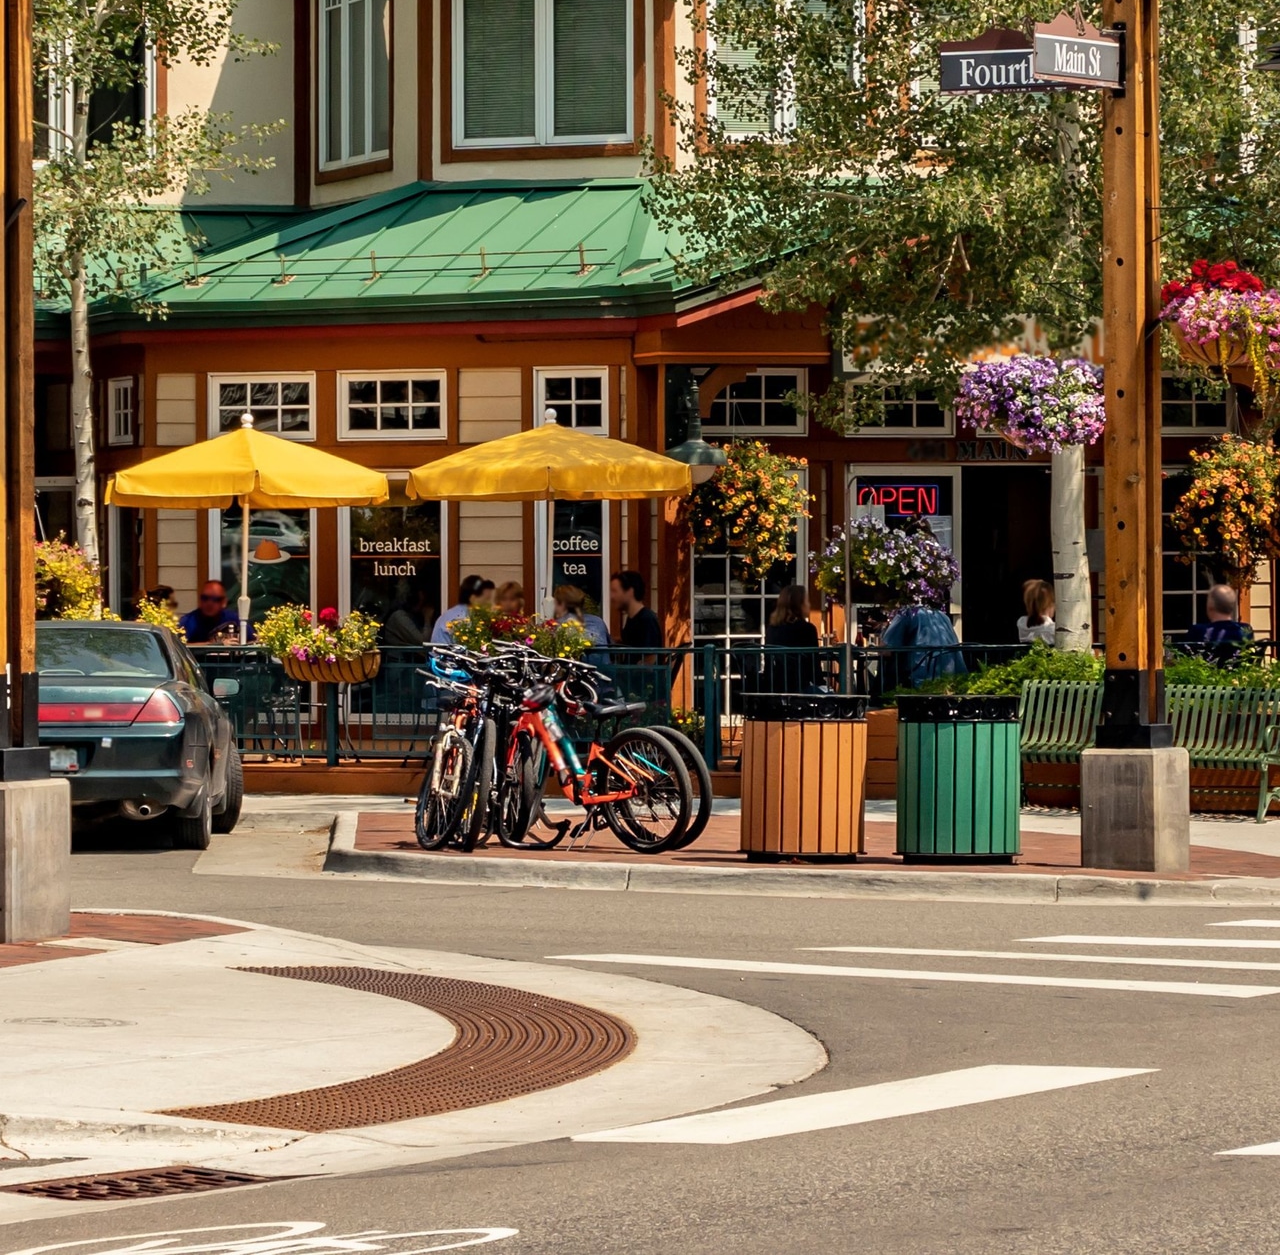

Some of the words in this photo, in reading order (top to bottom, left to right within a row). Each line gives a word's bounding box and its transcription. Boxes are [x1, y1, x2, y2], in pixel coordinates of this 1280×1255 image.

[1054, 42, 1087, 75] Main
[1089, 46, 1102, 77] St
[858, 487, 937, 514] OPEN
[359, 537, 431, 552] breakfast
[553, 536, 599, 551] coffee
[374, 562, 417, 576] lunch
[563, 562, 587, 575] tea
